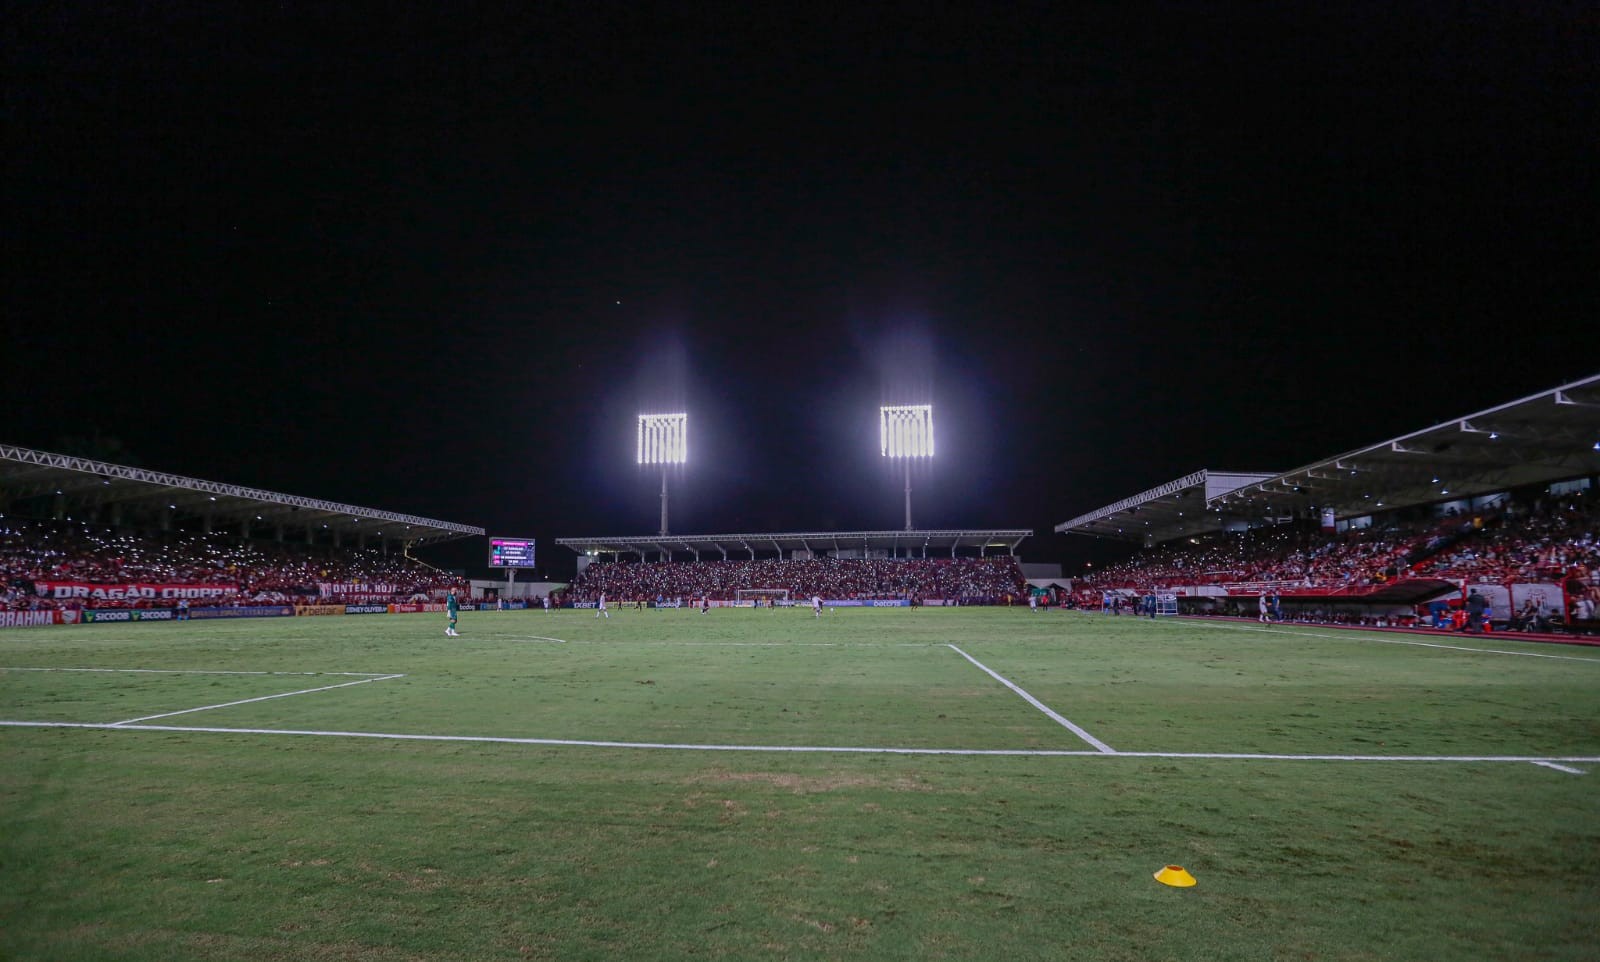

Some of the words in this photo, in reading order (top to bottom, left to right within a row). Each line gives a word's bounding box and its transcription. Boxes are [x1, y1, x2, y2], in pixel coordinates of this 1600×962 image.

[53, 585, 156, 600] DRAGÃO
[333, 583, 372, 594] ONTEM,
[0, 610, 53, 628] BRAHMA
[95, 612, 130, 622] SICOOB
[141, 610, 172, 620] SICOOB
